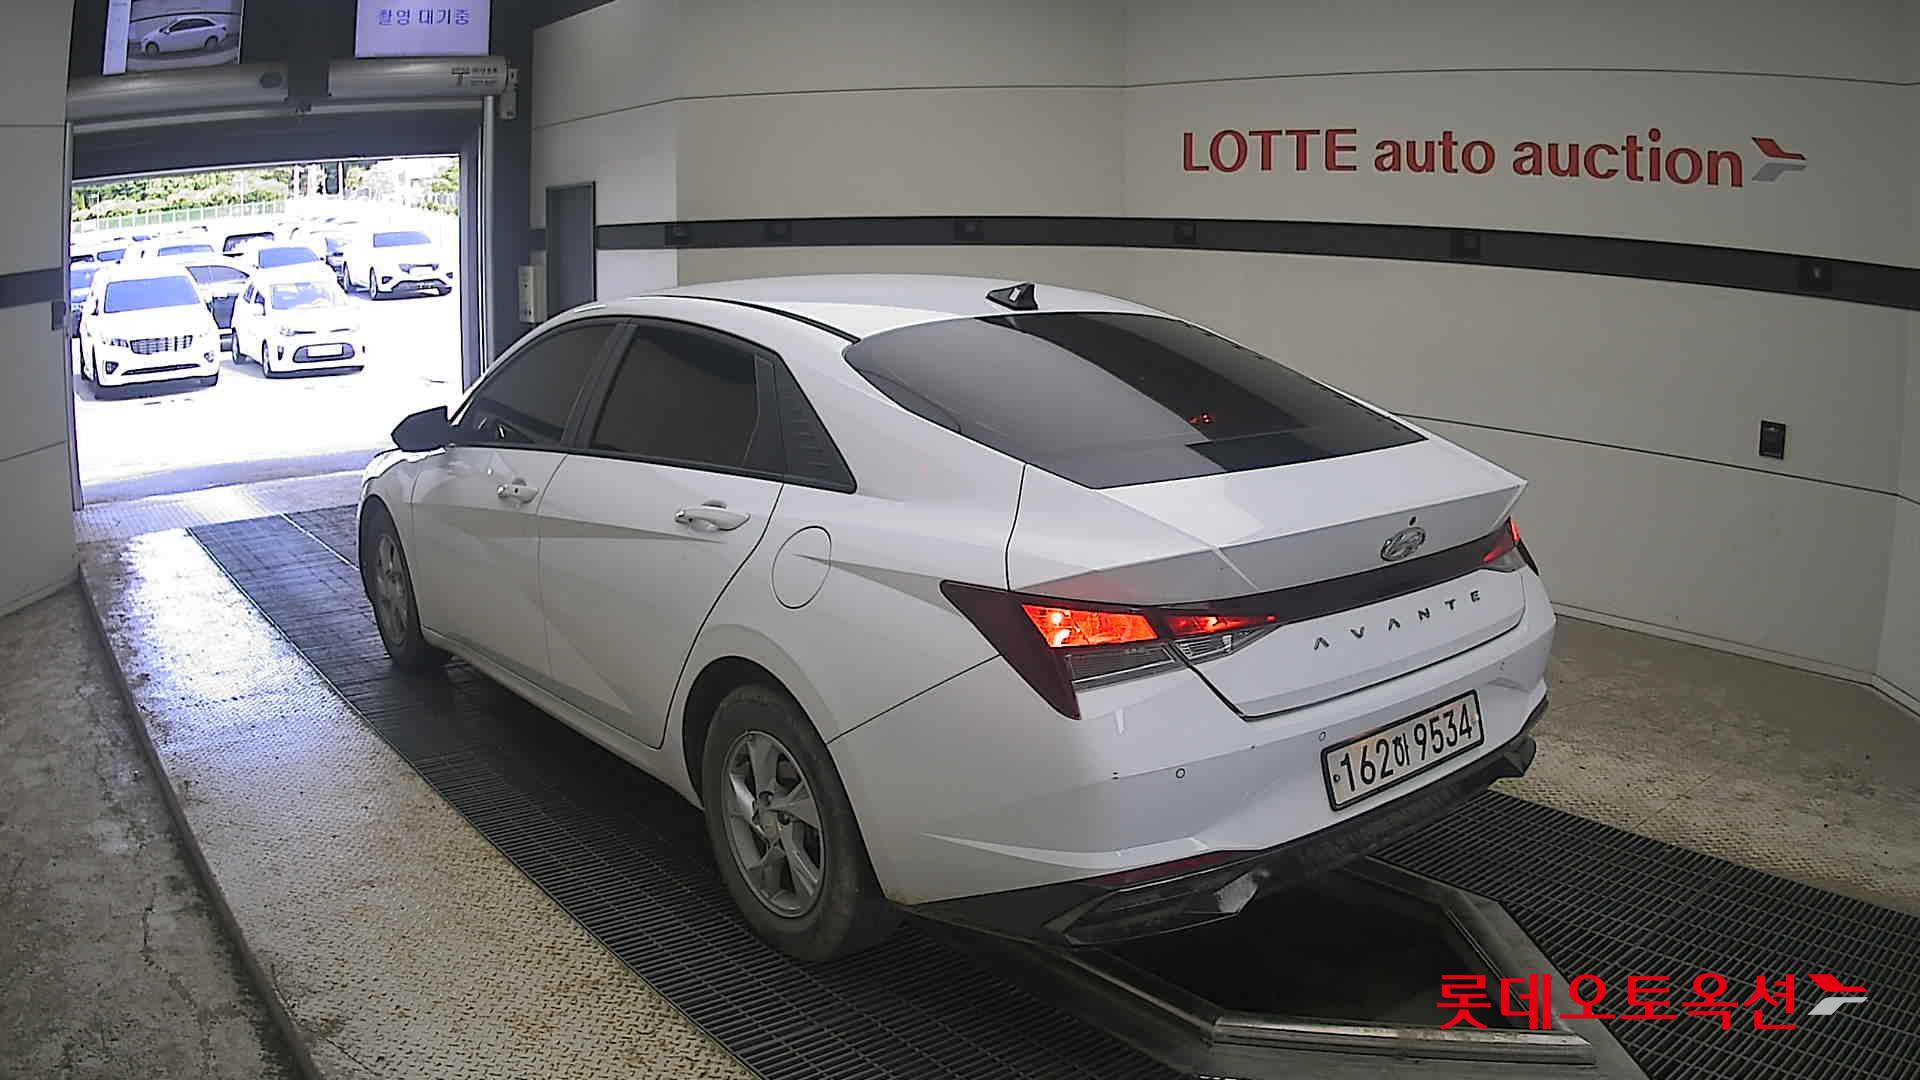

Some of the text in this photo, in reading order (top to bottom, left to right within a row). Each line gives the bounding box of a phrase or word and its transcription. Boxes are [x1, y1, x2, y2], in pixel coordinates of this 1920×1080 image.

[417, 8, 471, 26] 대기중
[1183, 128, 1744, 188] LOTTE auto auction
[1313, 590, 1482, 651] AVANTE
[1413, 703, 1473, 761] 9534
